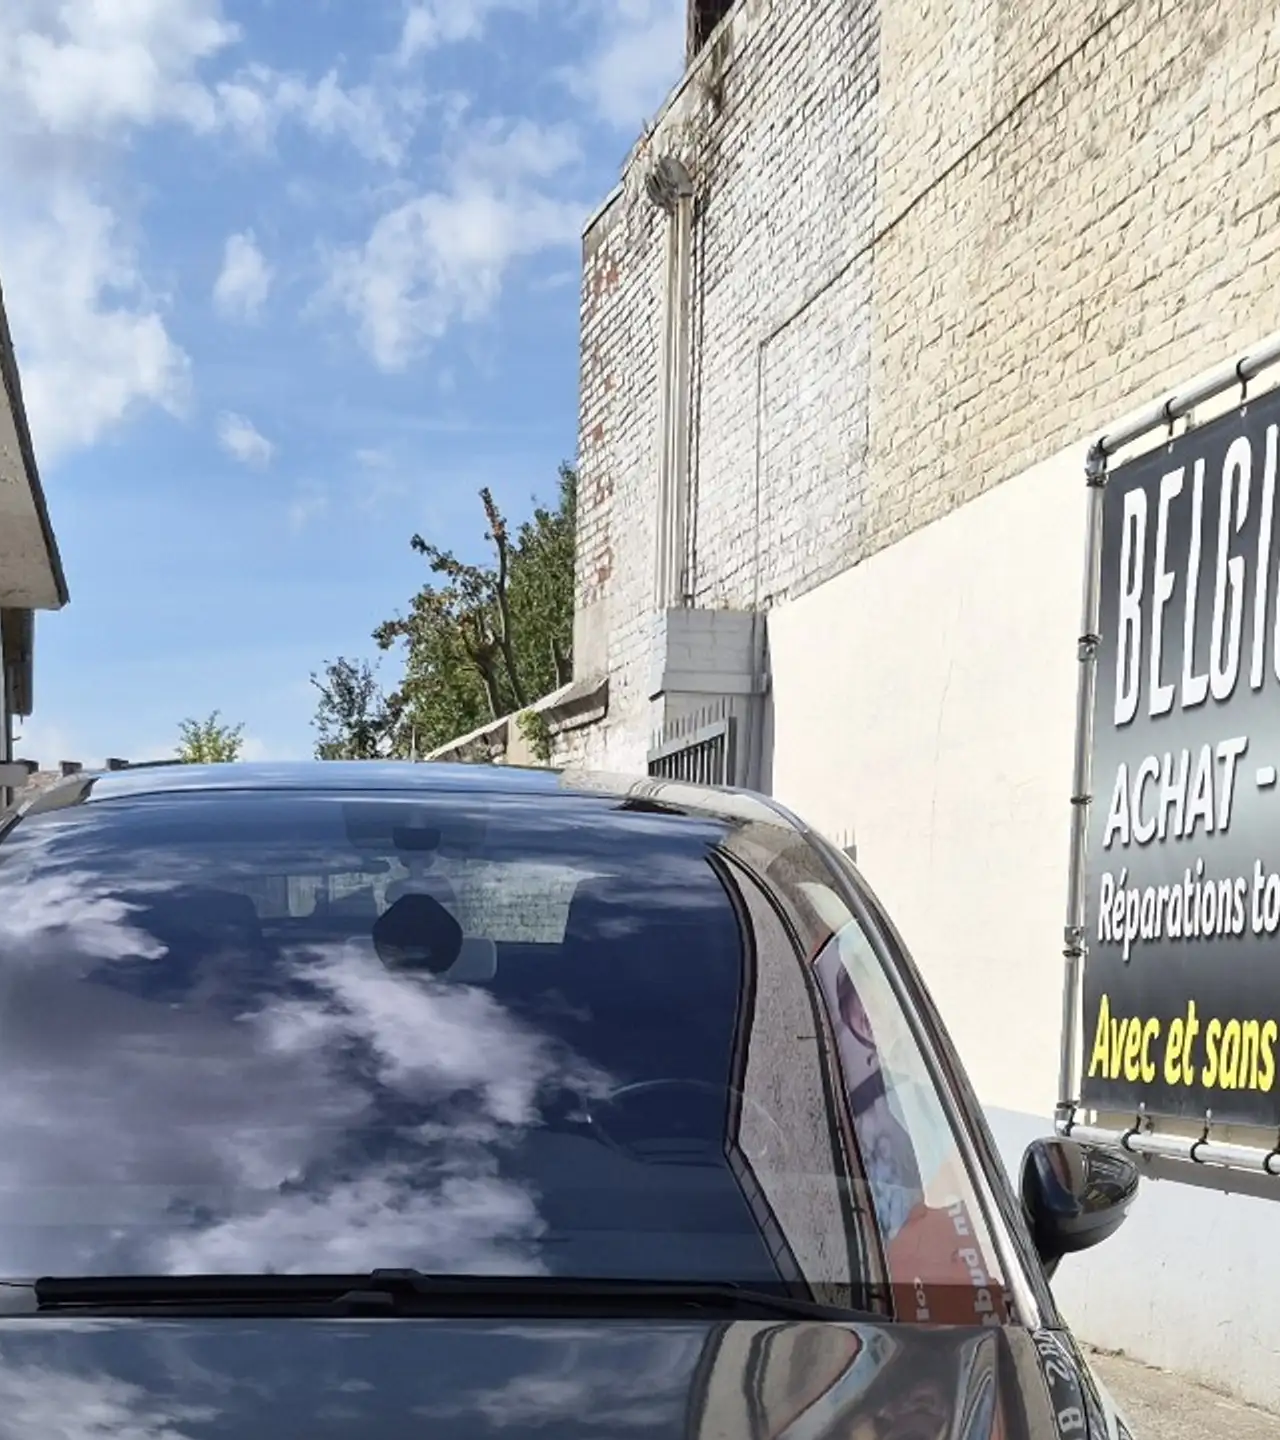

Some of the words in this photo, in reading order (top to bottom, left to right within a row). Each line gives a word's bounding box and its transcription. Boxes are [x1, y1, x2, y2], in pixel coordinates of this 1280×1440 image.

[1103, 737, 1246, 848] ACHAT
[1096, 853, 1245, 960] Réparations
[1088, 994, 1158, 1081] Avec
[1164, 1001, 1200, 1085] et
[1202, 1016, 1278, 1095] sans
